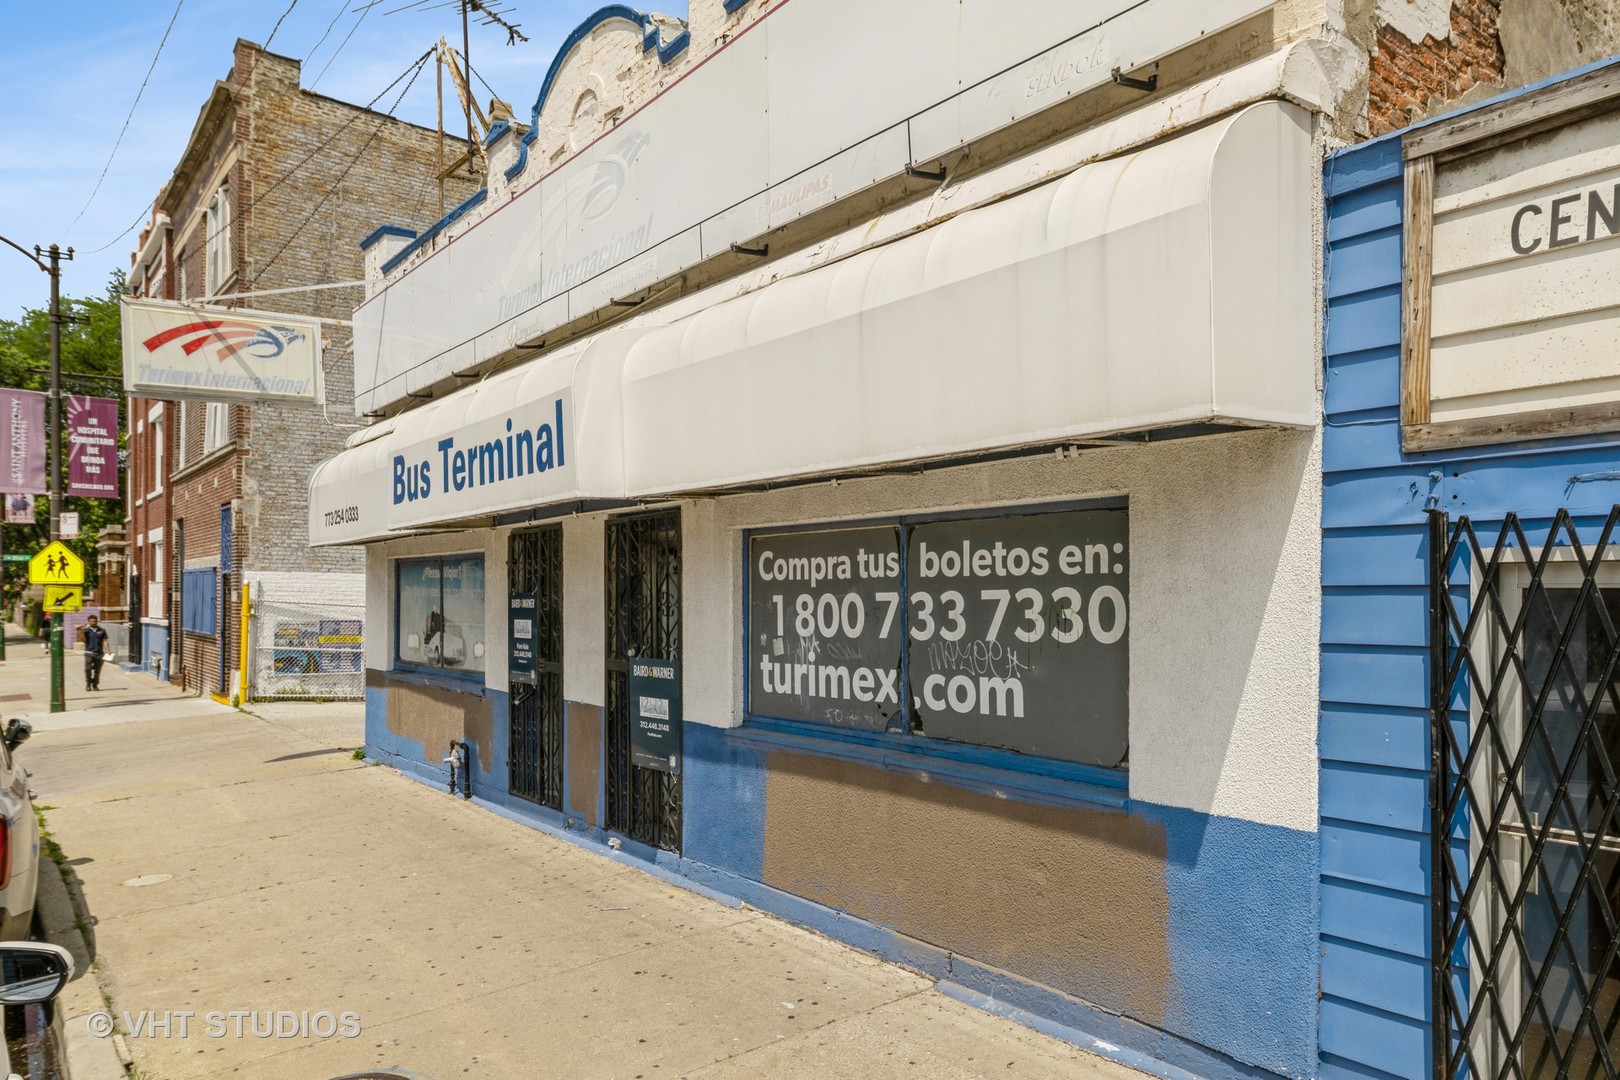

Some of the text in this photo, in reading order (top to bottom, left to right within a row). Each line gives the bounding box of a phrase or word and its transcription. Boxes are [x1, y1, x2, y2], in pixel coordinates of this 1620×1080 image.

[1510, 183, 1620, 255] CEN
[497, 279, 543, 322] Turimex
[544, 211, 654, 297] Internacional
[138, 362, 203, 387] Turimex
[10, 398, 21, 449] ANTHONY
[70, 435, 115, 446] COMUNITARIO
[77, 426, 108, 436] HOSPITAL
[80, 455, 105, 465] BRINDA
[86, 446, 100, 455] QUE
[393, 399, 566, 505] Bus Terminal
[758, 540, 1124, 588] Compra tus boletos en:
[772, 594, 785, 637] 1
[794, 592, 866, 640] 800
[980, 584, 1128, 645] 7330
